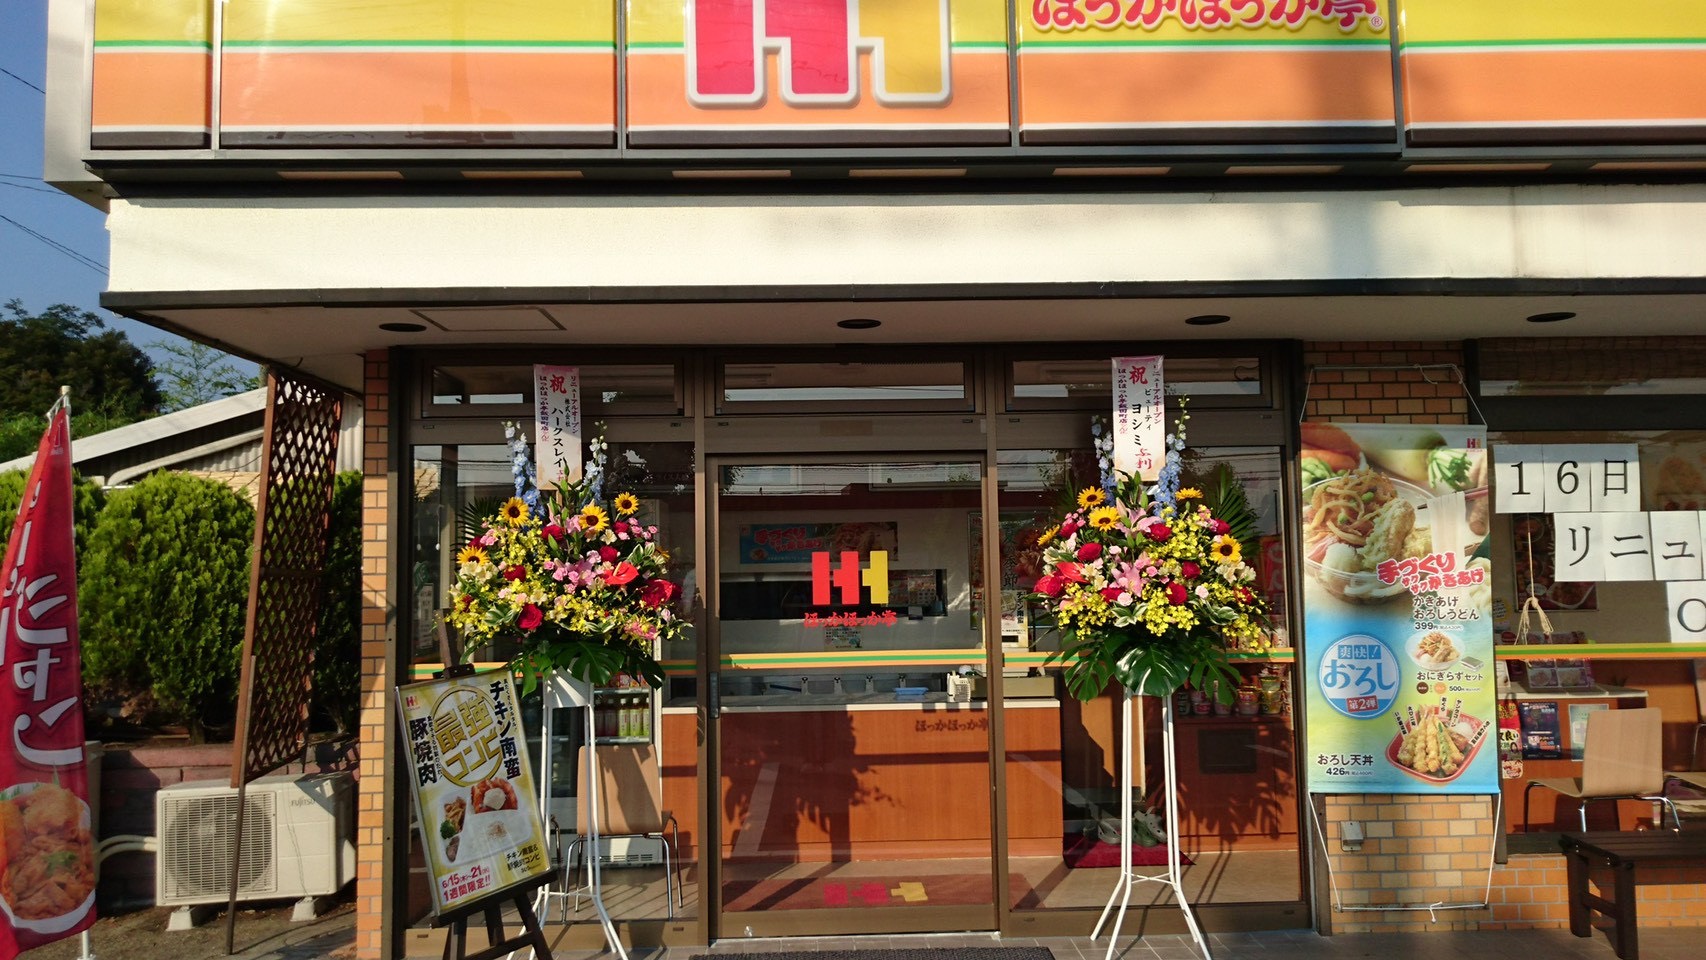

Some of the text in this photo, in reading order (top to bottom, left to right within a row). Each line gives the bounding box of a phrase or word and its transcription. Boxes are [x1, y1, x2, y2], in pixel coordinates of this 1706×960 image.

[549, 374, 567, 394] 祝
[1129, 366, 1148, 384] 祝
[1144, 388, 1152, 431] ビューティ
[1131, 403, 1142, 446] ヨシミ
[551, 407, 564, 468] ハークスレイ
[1377, 552, 1456, 584] 手づくり
[1413, 596, 1459, 608] かきあげ
[803, 610, 898, 628] ほっかほっか亭
[1413, 609, 1480, 621] おろしうどん
[1414, 622, 1439, 631] 399円
[1339, 645, 1379, 659] 爽快!
[1322, 659, 1396, 696] おろし
[1416, 672, 1484, 682] おにぎらずセット
[1348, 697, 1378, 711] 第2弾
[434, 697, 495, 754] 最強
[489, 680, 522, 781] チキン南蛮
[408, 715, 438, 788] 豚焼肉
[446, 726, 503, 783] コンビ
[1317, 754, 1374, 767] おろし天丼
[1325, 767, 1350, 777] 426円
[443, 874, 492, 902] 1週間限定!!
